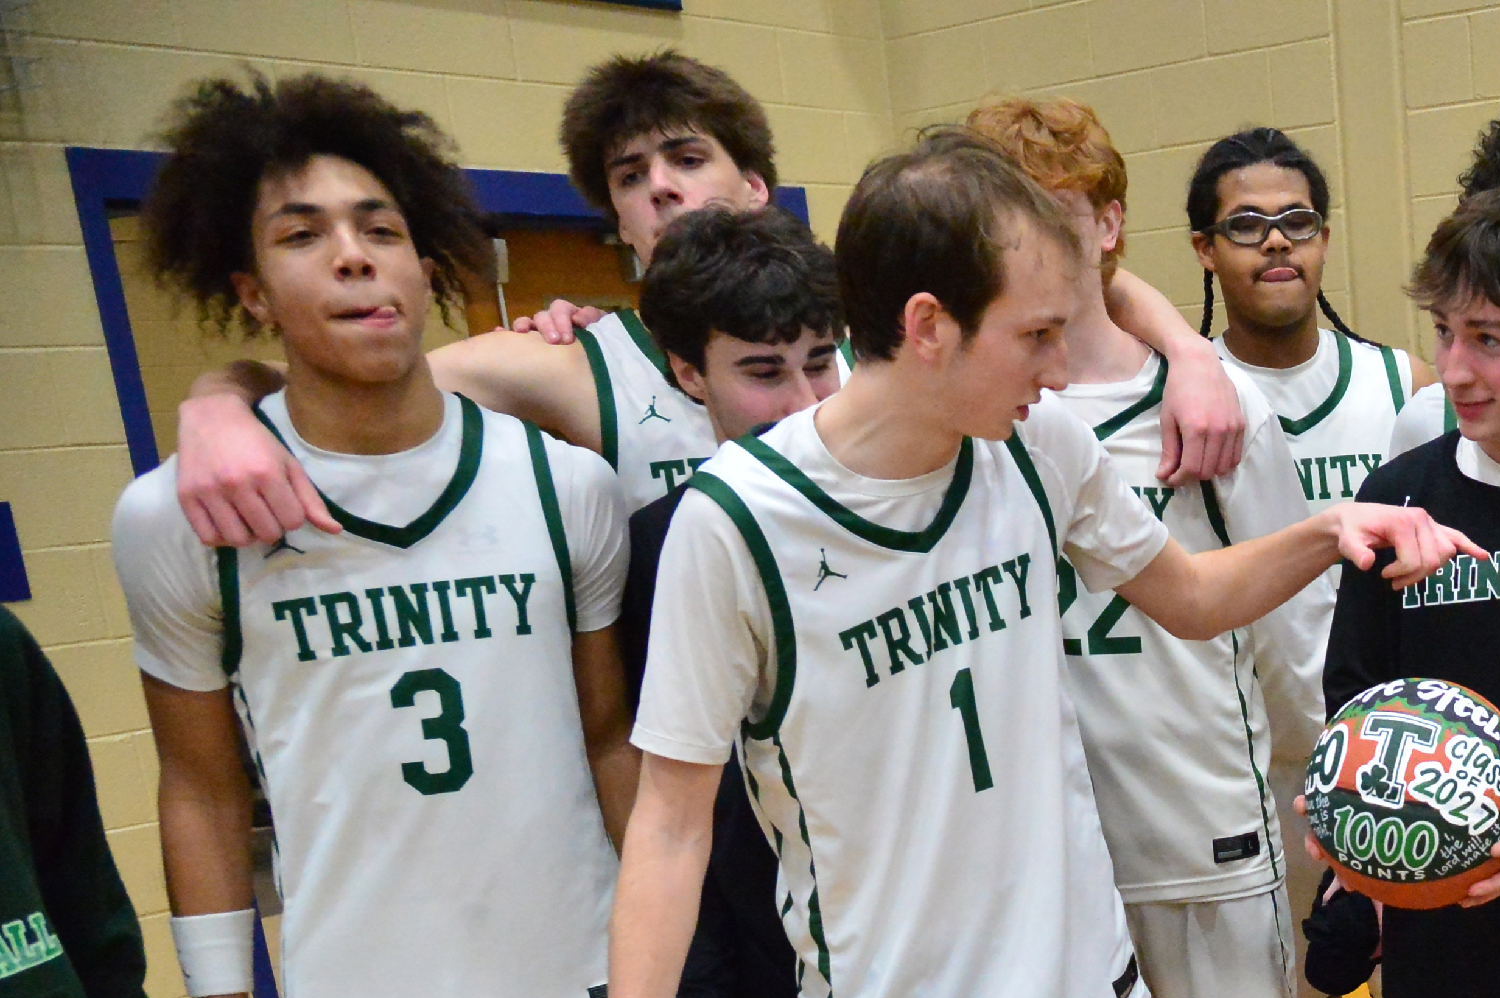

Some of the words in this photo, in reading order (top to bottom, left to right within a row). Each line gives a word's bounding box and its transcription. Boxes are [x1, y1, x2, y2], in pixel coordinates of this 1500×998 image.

[272, 573, 536, 662] TRINITY
[838, 552, 1032, 689] TRINITY
[390, 667, 474, 796] 3
[950, 667, 994, 793] 1
[1333, 804, 1439, 871] 1000
[1411, 767, 1496, 832] 2027
[1338, 852, 1427, 880] POINTS
[1440, 840, 1463, 858] the
